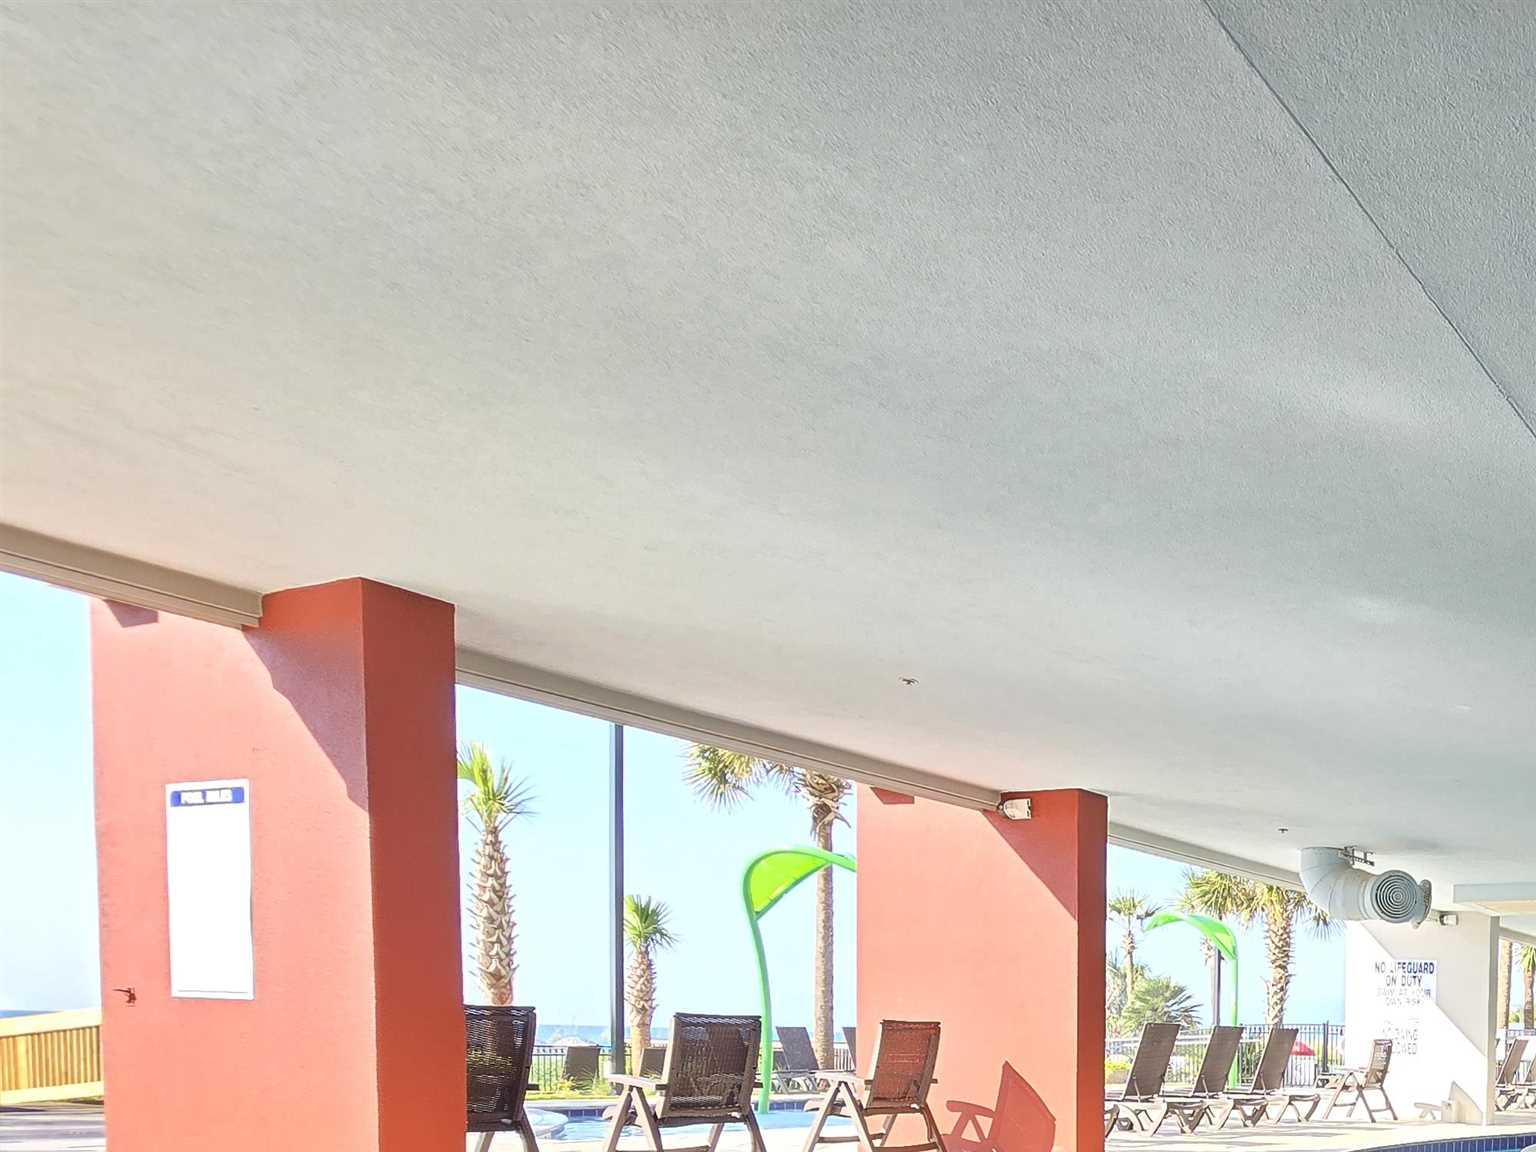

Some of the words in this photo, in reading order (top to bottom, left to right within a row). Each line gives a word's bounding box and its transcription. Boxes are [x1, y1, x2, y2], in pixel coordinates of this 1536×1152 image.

[1375, 961, 1386, 973] NO
[1389, 961, 1435, 974] LIFEGUARD
[1386, 975, 1397, 987] ON
[1401, 975, 1422, 987] DUTY
